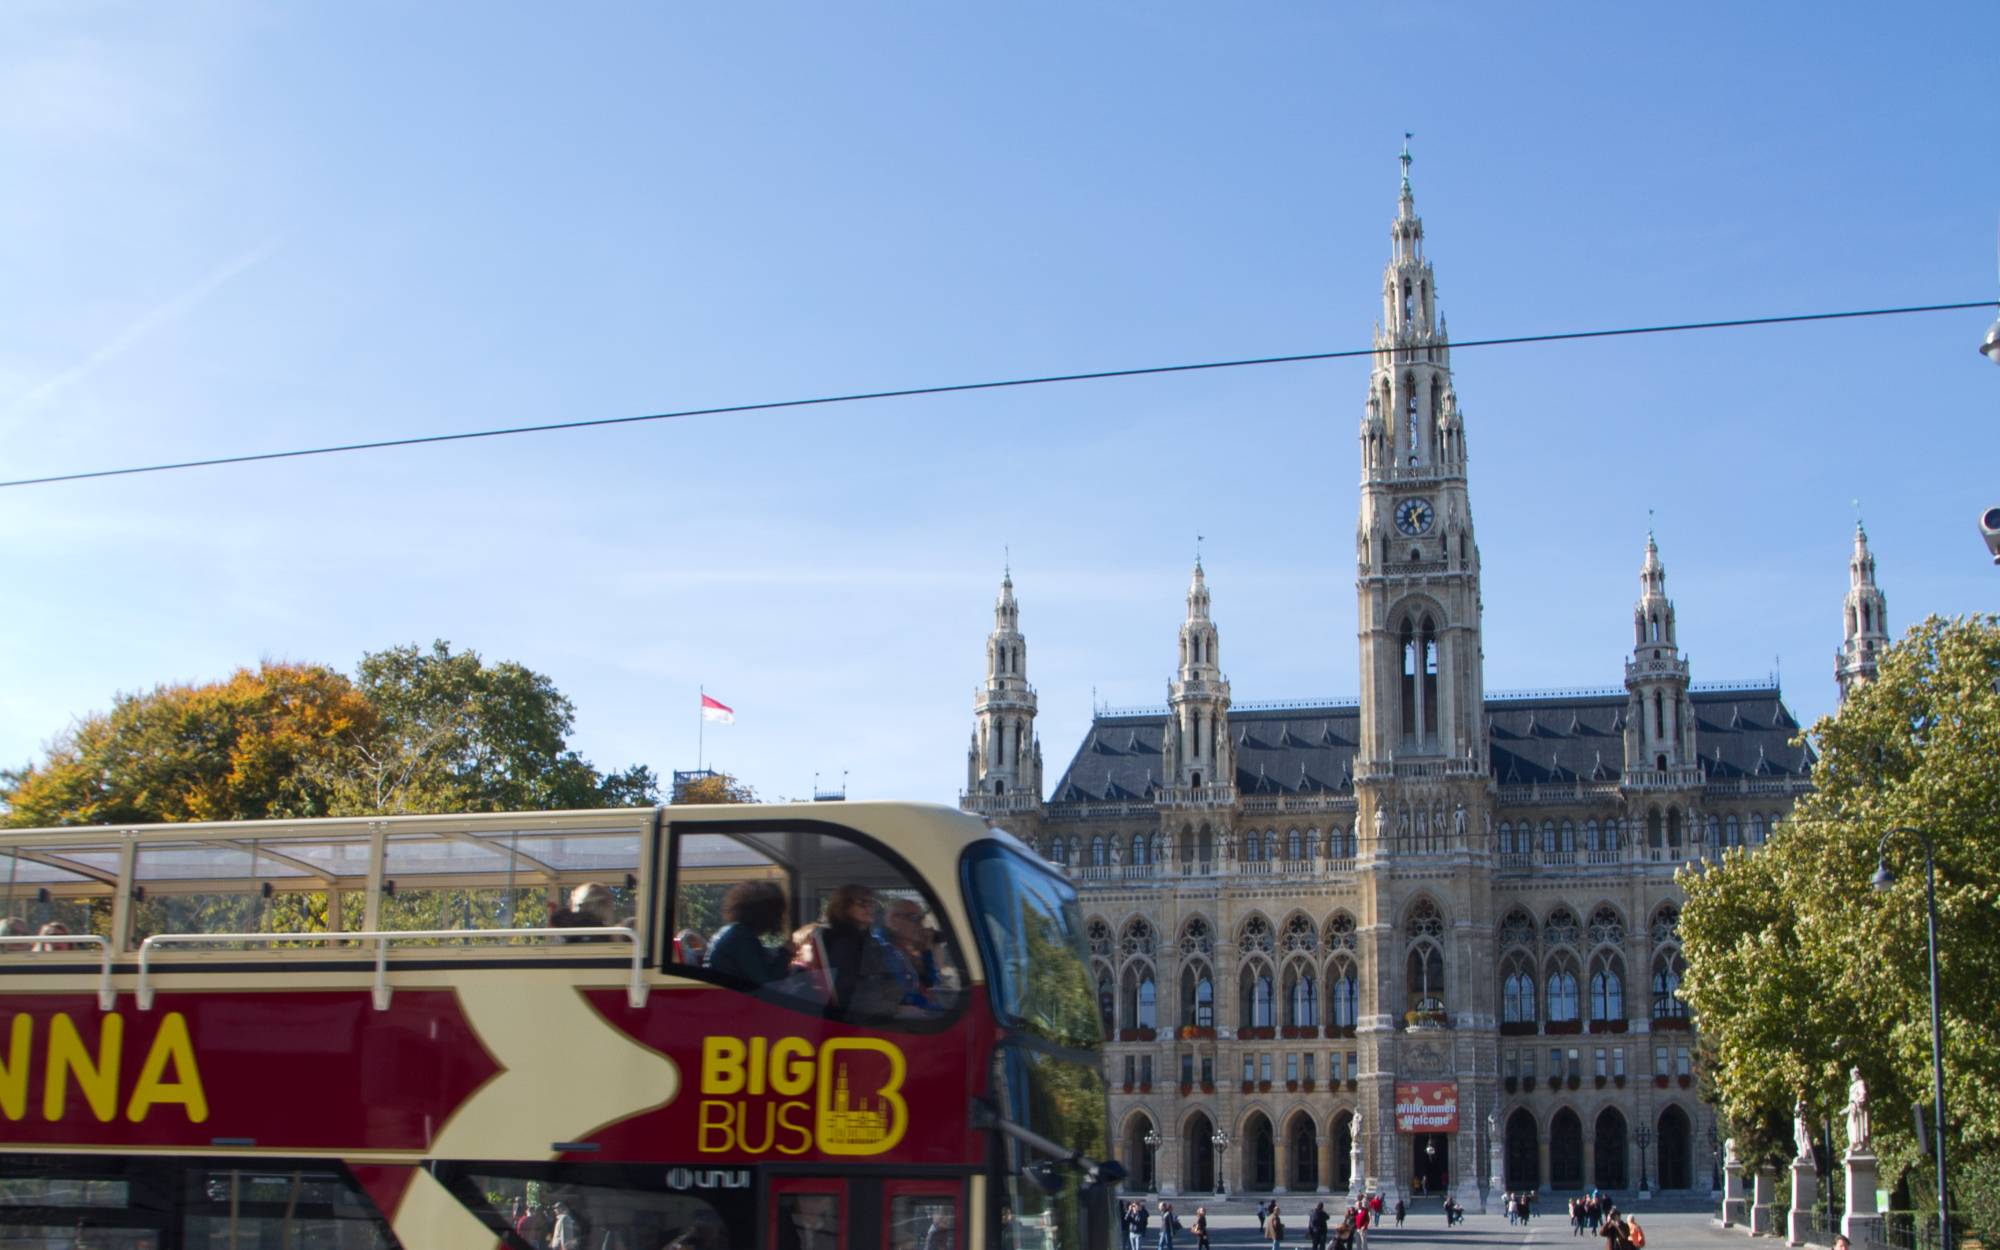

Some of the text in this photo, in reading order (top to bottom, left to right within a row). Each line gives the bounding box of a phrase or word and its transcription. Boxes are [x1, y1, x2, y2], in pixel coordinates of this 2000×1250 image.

[702, 1036, 816, 1096] BIG
[1396, 1104, 1457, 1114] Willkommen
[1404, 1115, 1449, 1125] Welcome
[699, 1100, 813, 1154] BUS
